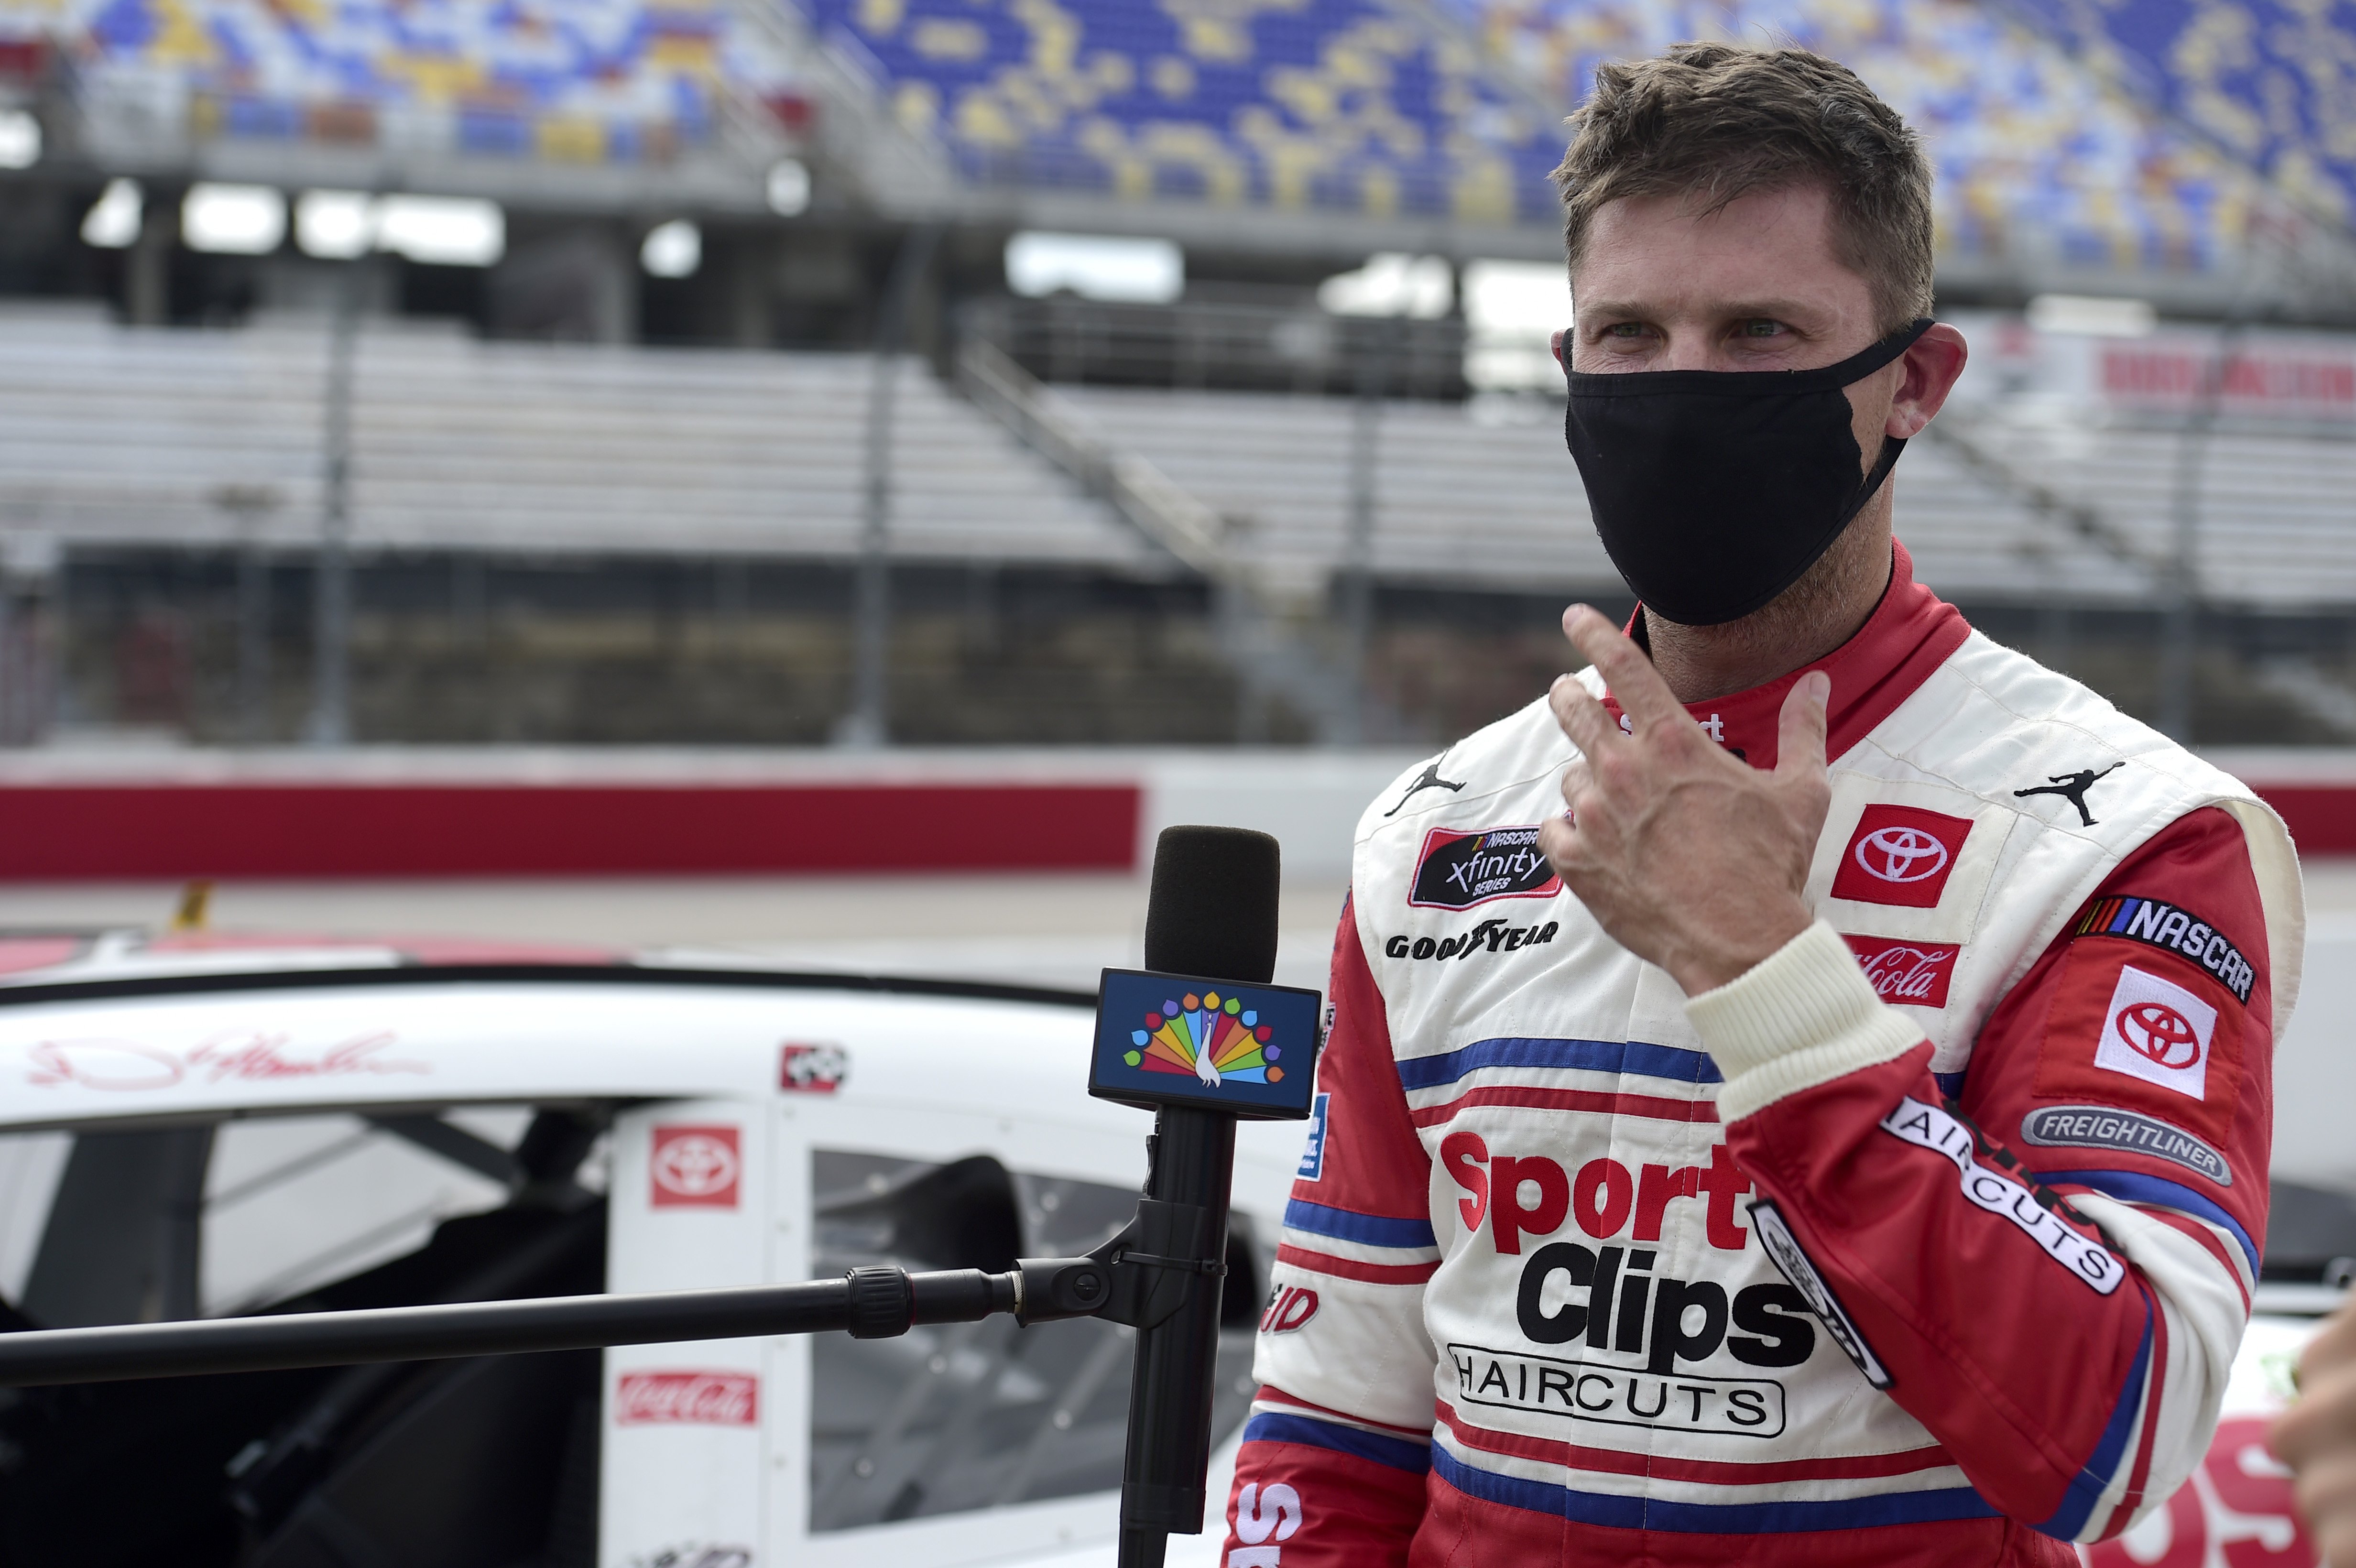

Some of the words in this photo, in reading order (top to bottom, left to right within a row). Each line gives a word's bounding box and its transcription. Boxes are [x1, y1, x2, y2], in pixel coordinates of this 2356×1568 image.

[1445, 847, 1547, 893] xfinity
[1472, 877, 1512, 897] SERIES
[1385, 918, 1559, 961] GOODYEAR
[2126, 900, 2253, 1001] NASCAR
[2040, 1115, 2217, 1173] FREIGHTLINER
[1440, 1131, 1752, 1255] Sport
[1516, 1241, 1815, 1375] Clips
[1454, 1354, 1767, 1426] HAIRCUTS
